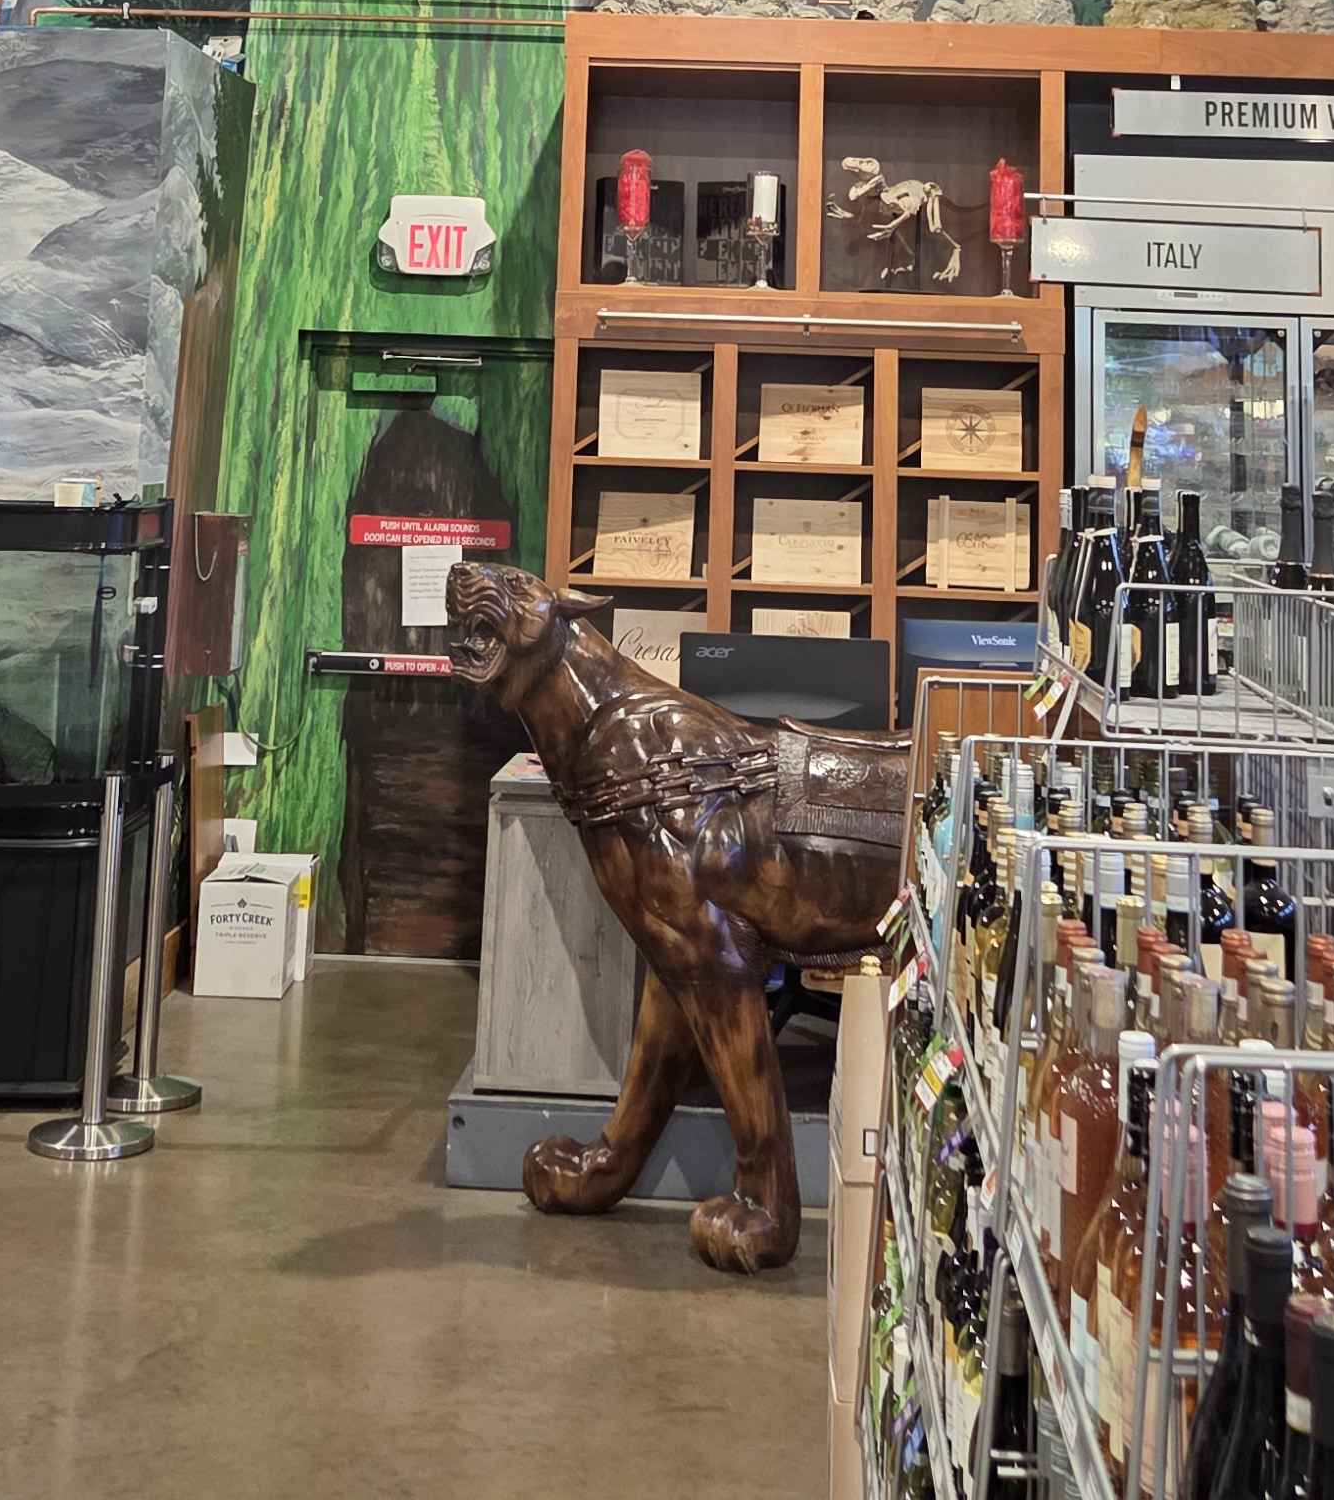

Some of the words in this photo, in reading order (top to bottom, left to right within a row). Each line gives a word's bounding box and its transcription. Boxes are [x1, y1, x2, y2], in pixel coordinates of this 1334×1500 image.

[1204, 100, 1321, 131] PREMIUM
[407, 224, 468, 269] EXIT
[1146, 242, 1203, 270] ITALY
[380, 520, 400, 530] PUSH
[401, 521, 423, 531] UNTIL
[424, 522, 449, 532] ALARM
[450, 523, 480, 533] SOUNDS
[364, 533, 384, 542] DOOR
[385, 533, 401, 542] CAN
[402, 534, 412, 543] BE
[413, 534, 442, 544] OPENED
[443, 535, 451, 544] IN
[452, 536, 460, 545] 15
[461, 536, 496, 546] SECONDS
[971, 634, 1018, 648] ViewSonic
[695, 645, 734, 658] acer
[384, 661, 405, 671] PUSH
[405, 662, 416, 671] TO
[417, 662, 436, 672] OPEN
[210, 913, 242, 926] FORTY
[242, 912, 273, 926] CREEK
